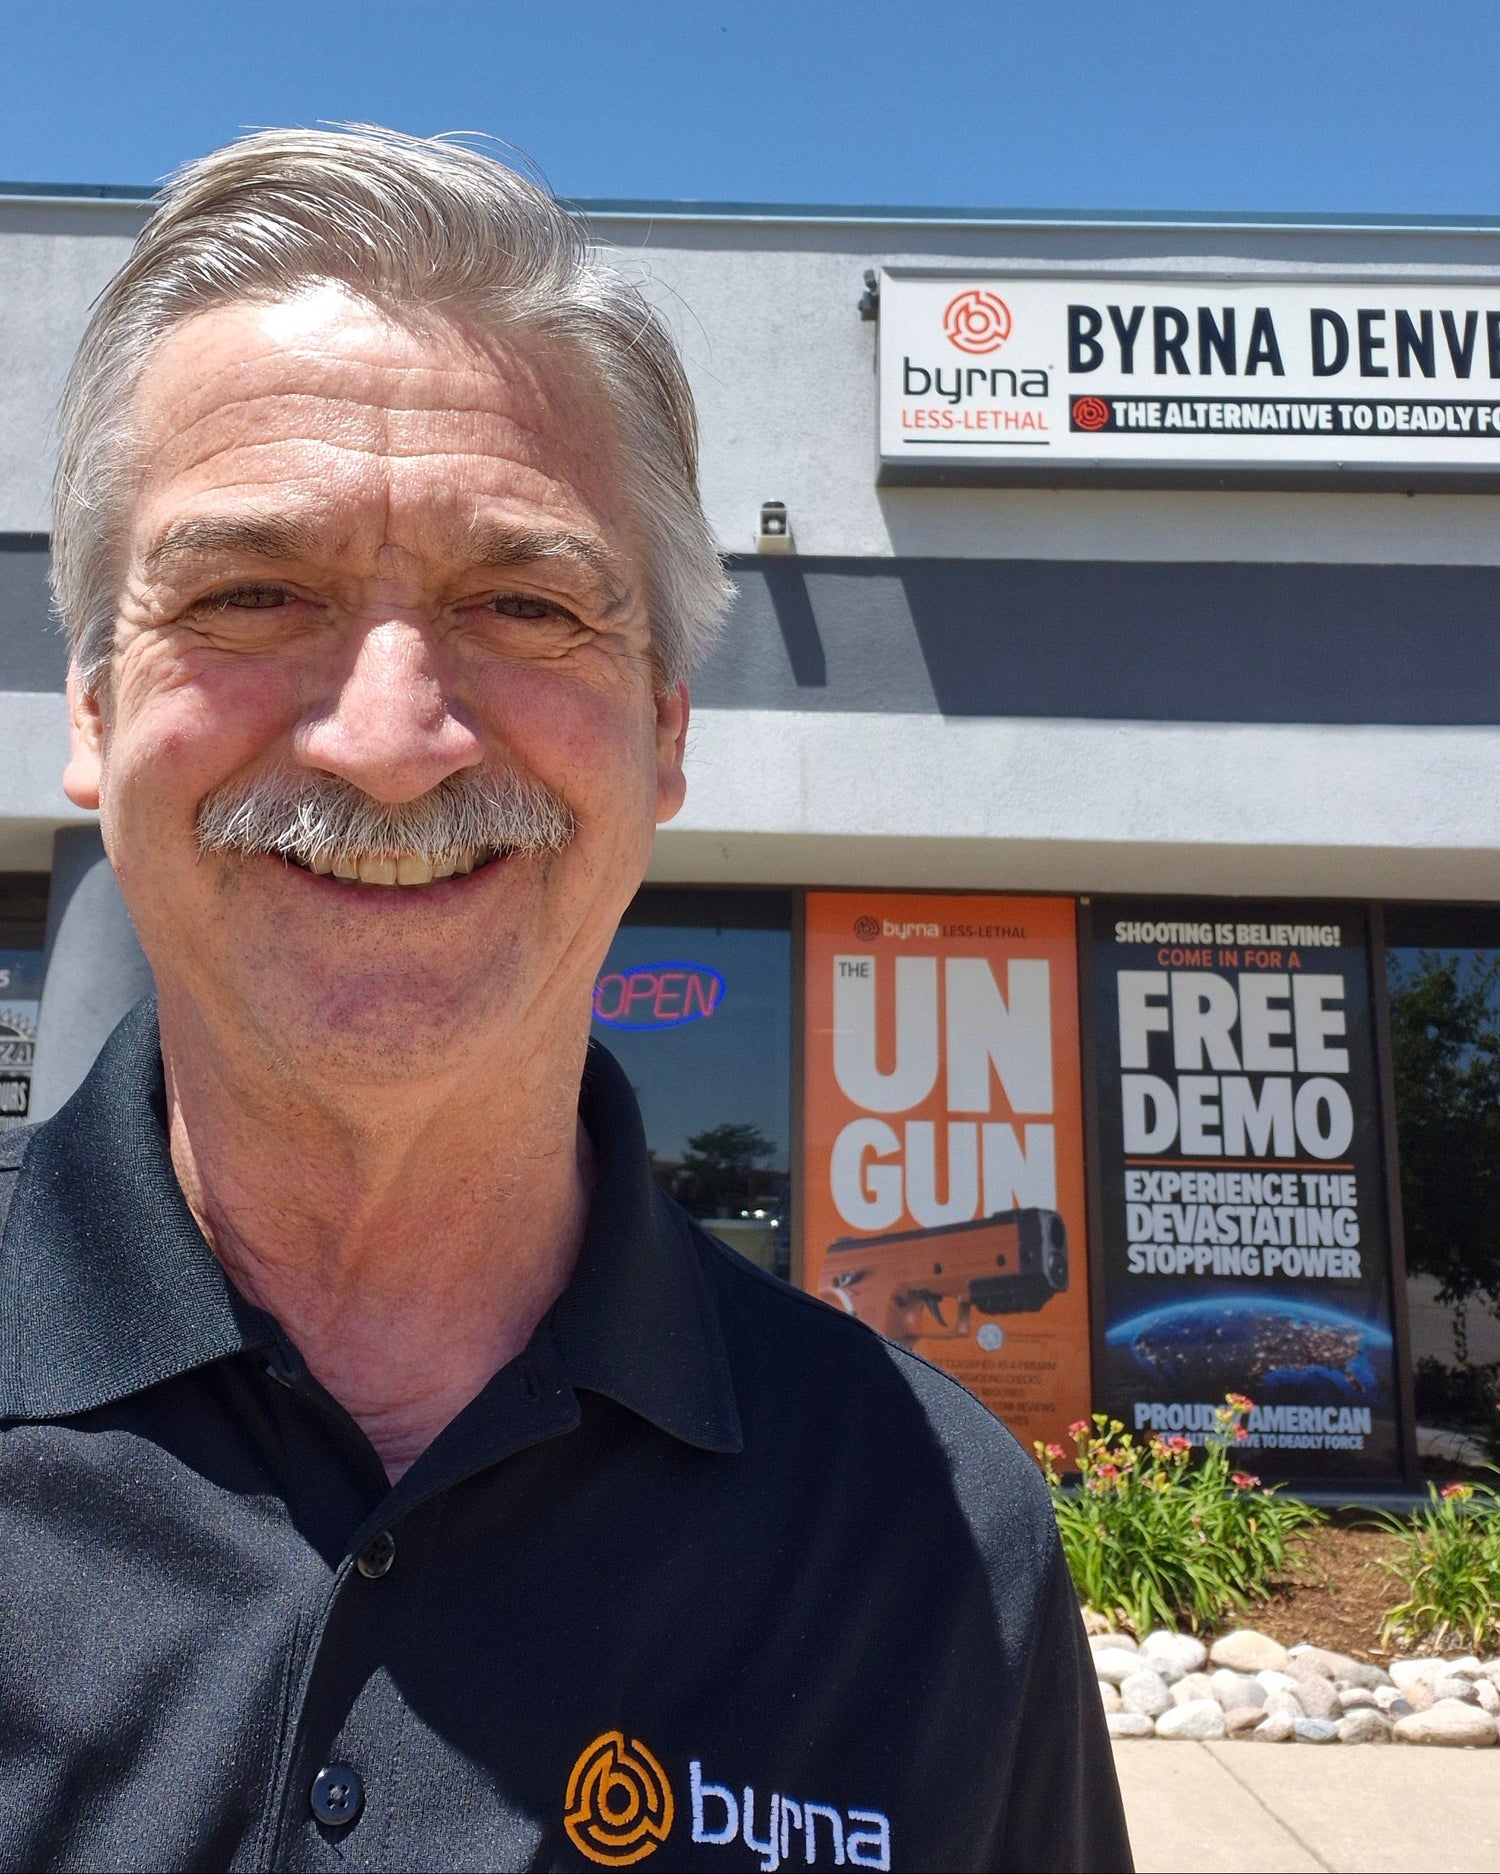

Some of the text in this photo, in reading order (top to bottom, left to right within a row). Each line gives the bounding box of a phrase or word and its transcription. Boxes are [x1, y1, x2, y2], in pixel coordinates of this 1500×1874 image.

[1067, 304, 1286, 376] BYRNA
[904, 356, 1049, 404] byrna
[902, 409, 1048, 430] LESS-LETHAL
[1112, 402, 1161, 428] THE
[1164, 403, 1333, 430] ALTERNATIVE
[1338, 405, 1373, 430] TO
[1376, 406, 1475, 431] DEADLY
[883, 918, 1028, 941] byrna LESS-LETHAL
[1115, 921, 1342, 947] SHOOTING IS BELIEVING!
[838, 961, 869, 978] THE
[1157, 948, 1301, 968] COME IN FOR A
[595, 973, 719, 1018] OPEN
[833, 955, 1053, 1114] UN
[1117, 970, 1349, 1073] FREE
[1121, 1074, 1354, 1160] DEMO
[830, 1118, 1057, 1230] GUN
[1124, 1170, 1358, 1206] EXPERIENCE THE
[1126, 1203, 1361, 1247] DEVASTATING
[1127, 1243, 1362, 1278] STOPPING POWER
[1133, 1402, 1371, 1435] PROUD AMERICAN
[1262, 1434, 1277, 1448] TO
[1278, 1434, 1323, 1449] DEADLY
[1324, 1435, 1364, 1450] FORCE
[690, 1761, 890, 1871] byrna
